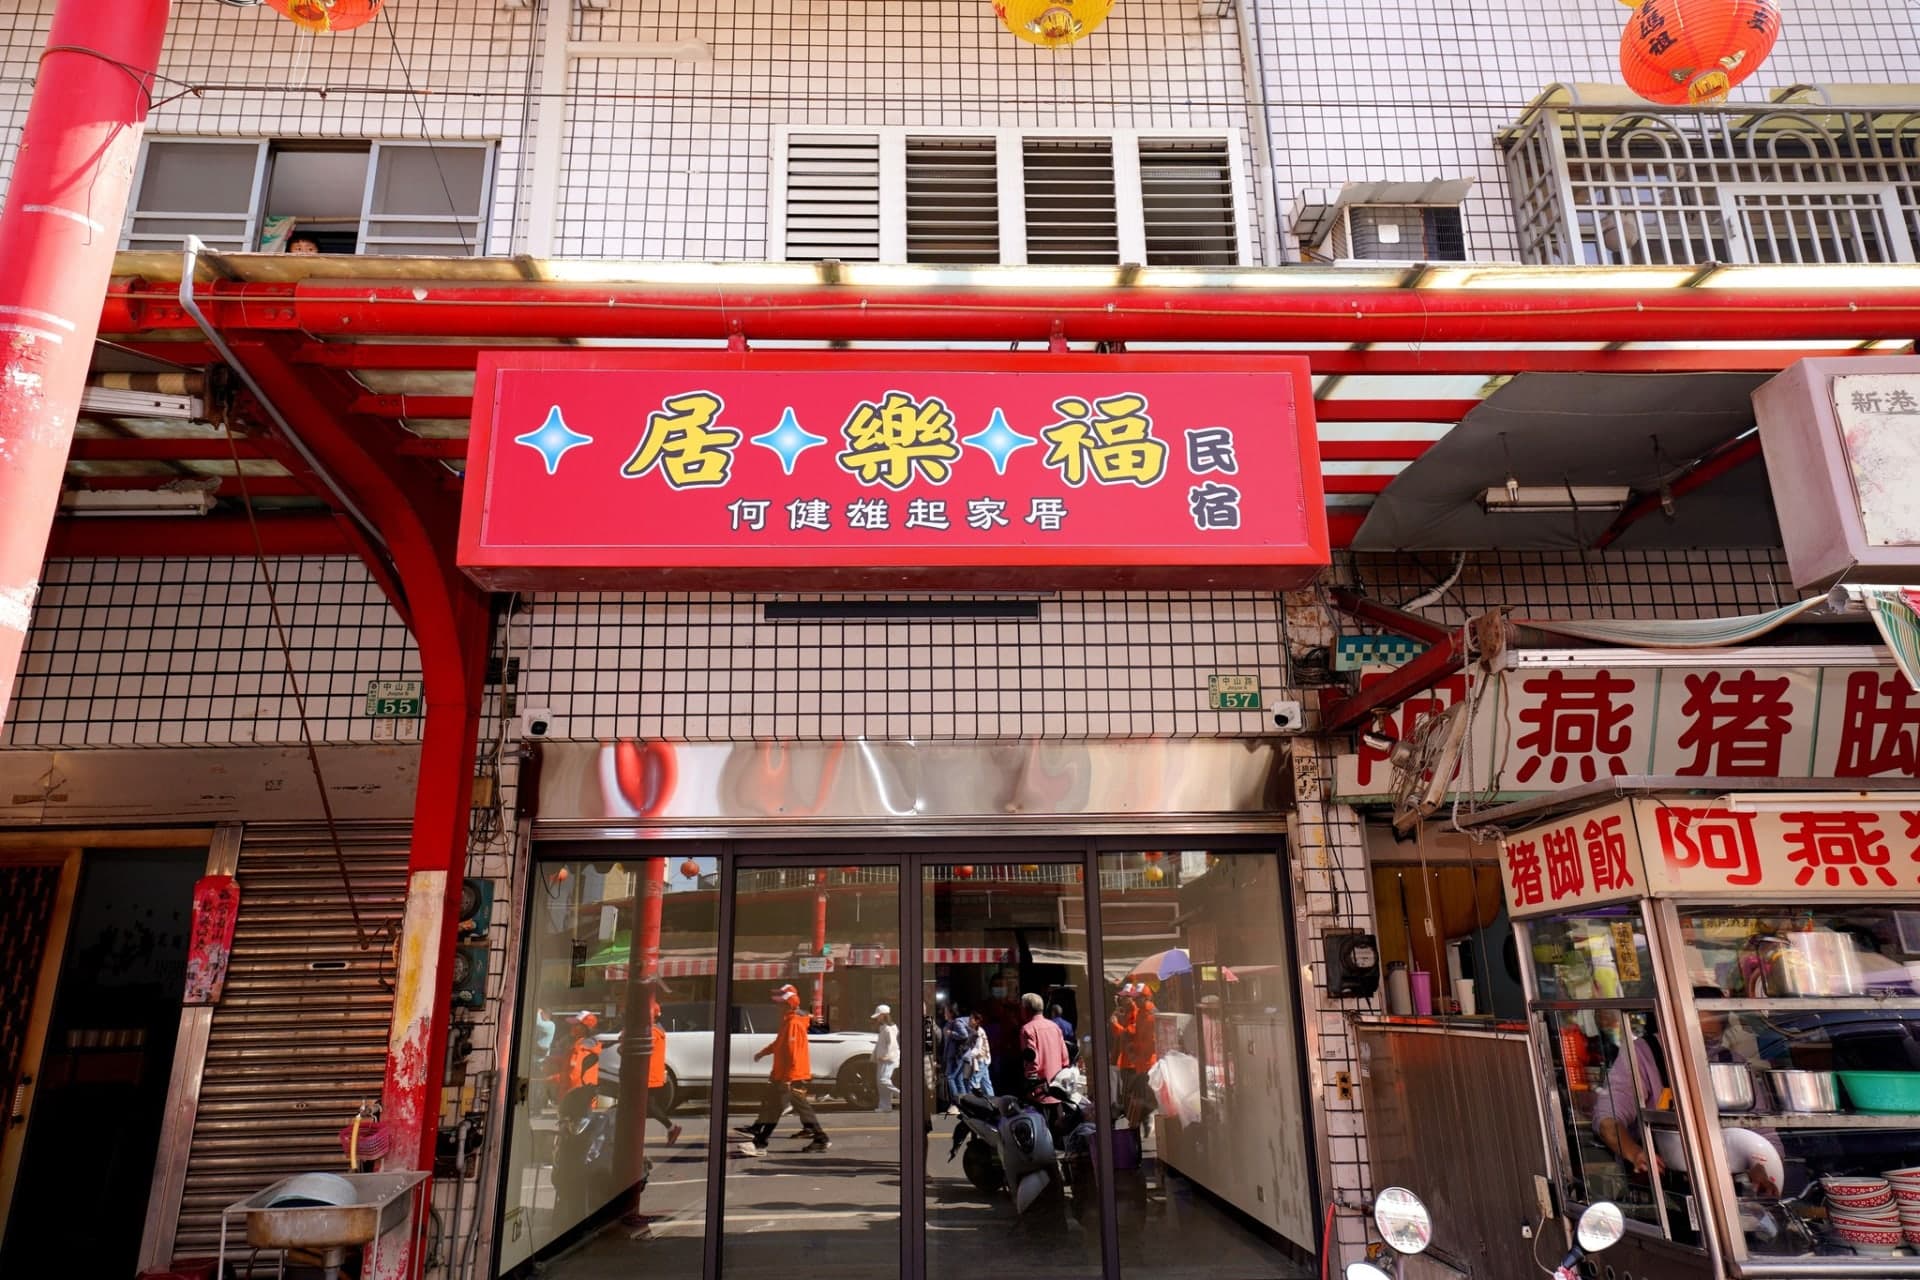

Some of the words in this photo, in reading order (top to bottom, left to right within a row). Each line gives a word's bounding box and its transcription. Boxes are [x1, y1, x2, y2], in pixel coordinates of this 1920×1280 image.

[1850, 389, 1919, 414] 新港
[1185, 427, 1241, 531] 民宿
[727, 497, 1069, 531] 何健雄起家厝
[383, 700, 412, 713] 55
[1226, 694, 1252, 707] 57
